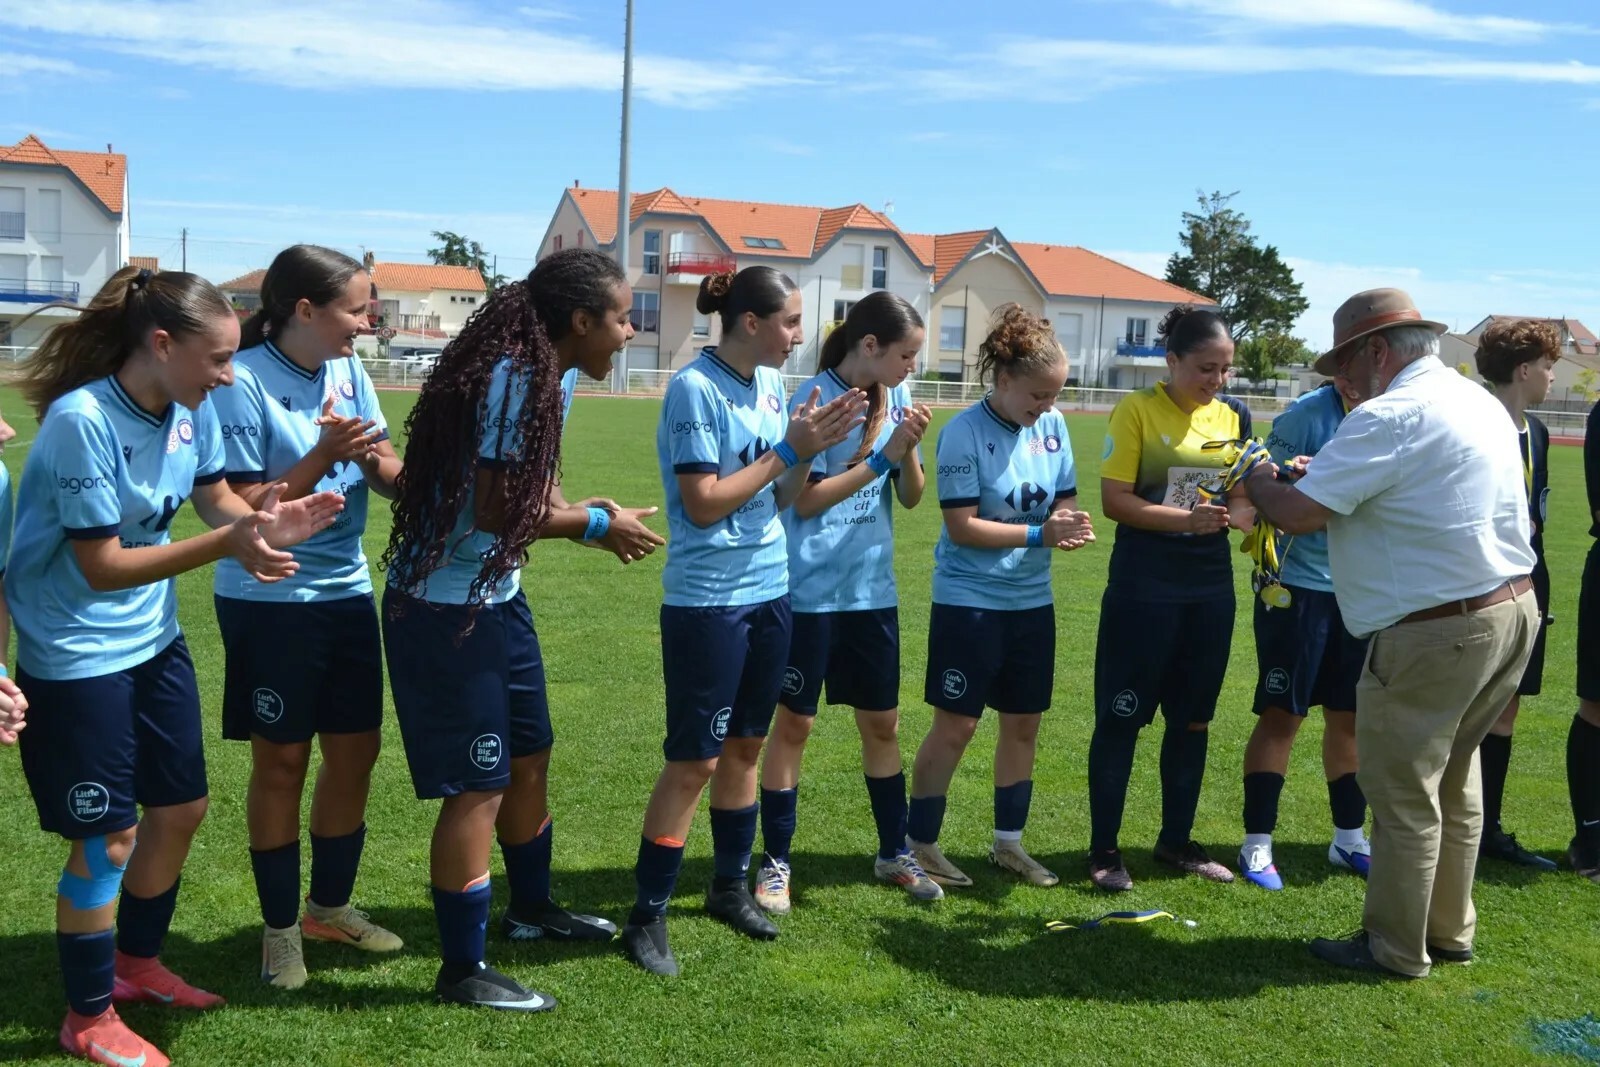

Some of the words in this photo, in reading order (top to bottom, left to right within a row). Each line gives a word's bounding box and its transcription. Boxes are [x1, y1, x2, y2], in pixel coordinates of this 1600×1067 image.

[946, 673, 962, 682] Little
[944, 685, 960, 694] Films
[258, 692, 275, 703] Little
[258, 706, 275, 718] Films
[478, 740, 497, 748] Little
[478, 748, 491, 756] Big
[75, 788, 100, 798] Little
[76, 799, 92, 808] Big
[76, 806, 104, 814] Films
